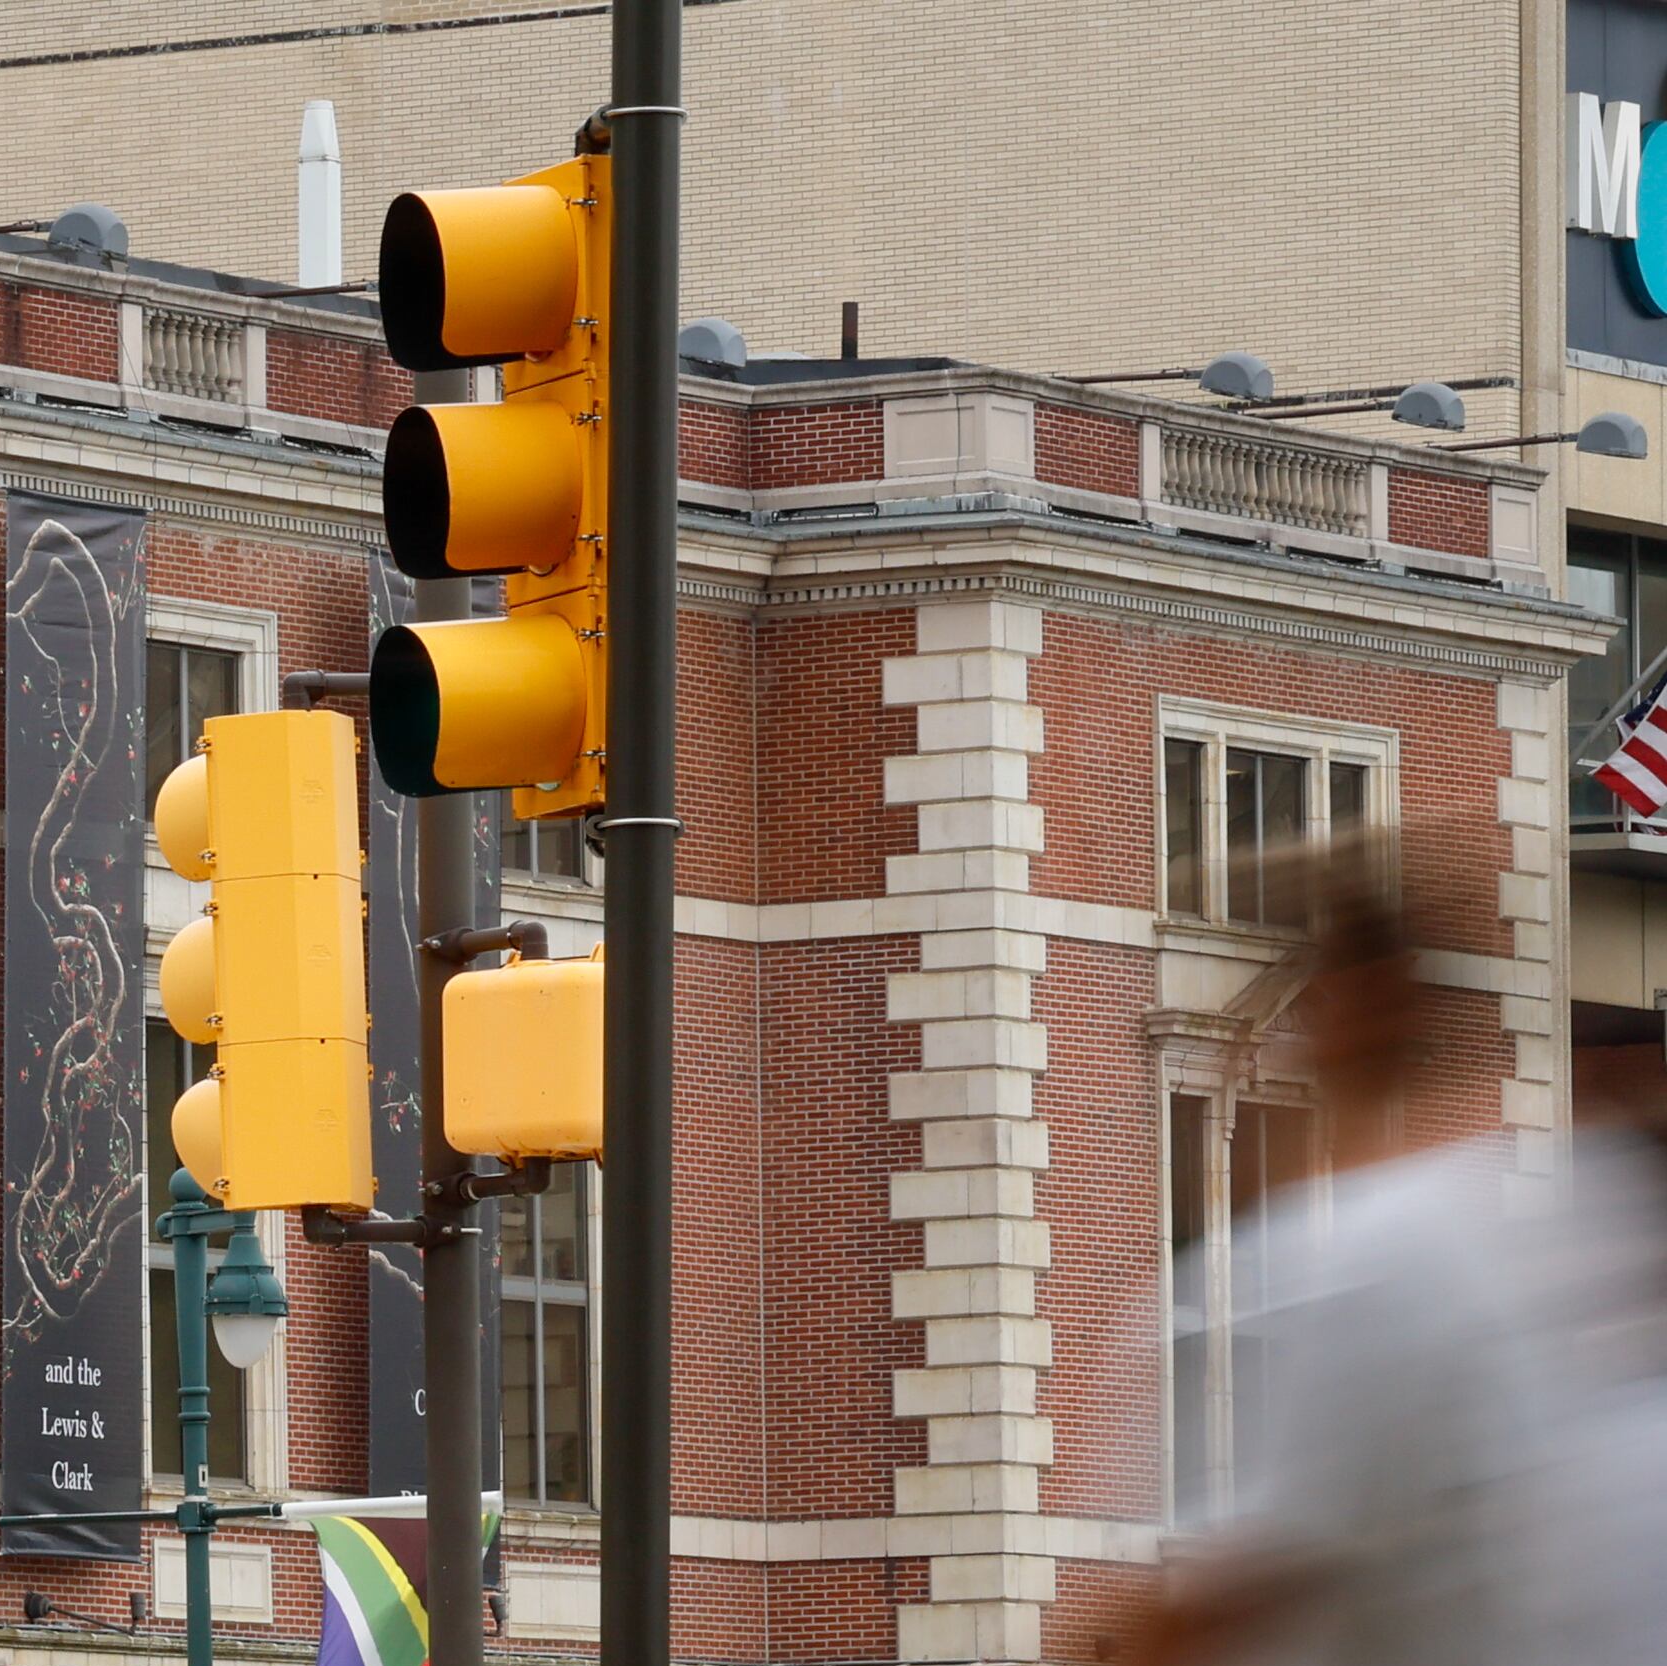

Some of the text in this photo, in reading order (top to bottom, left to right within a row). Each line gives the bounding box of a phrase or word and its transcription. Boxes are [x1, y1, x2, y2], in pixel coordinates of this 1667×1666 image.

[45, 1356, 101, 1386] and the
[41, 1407, 105, 1439] Lewis &
[51, 1461, 93, 1491] Clark
